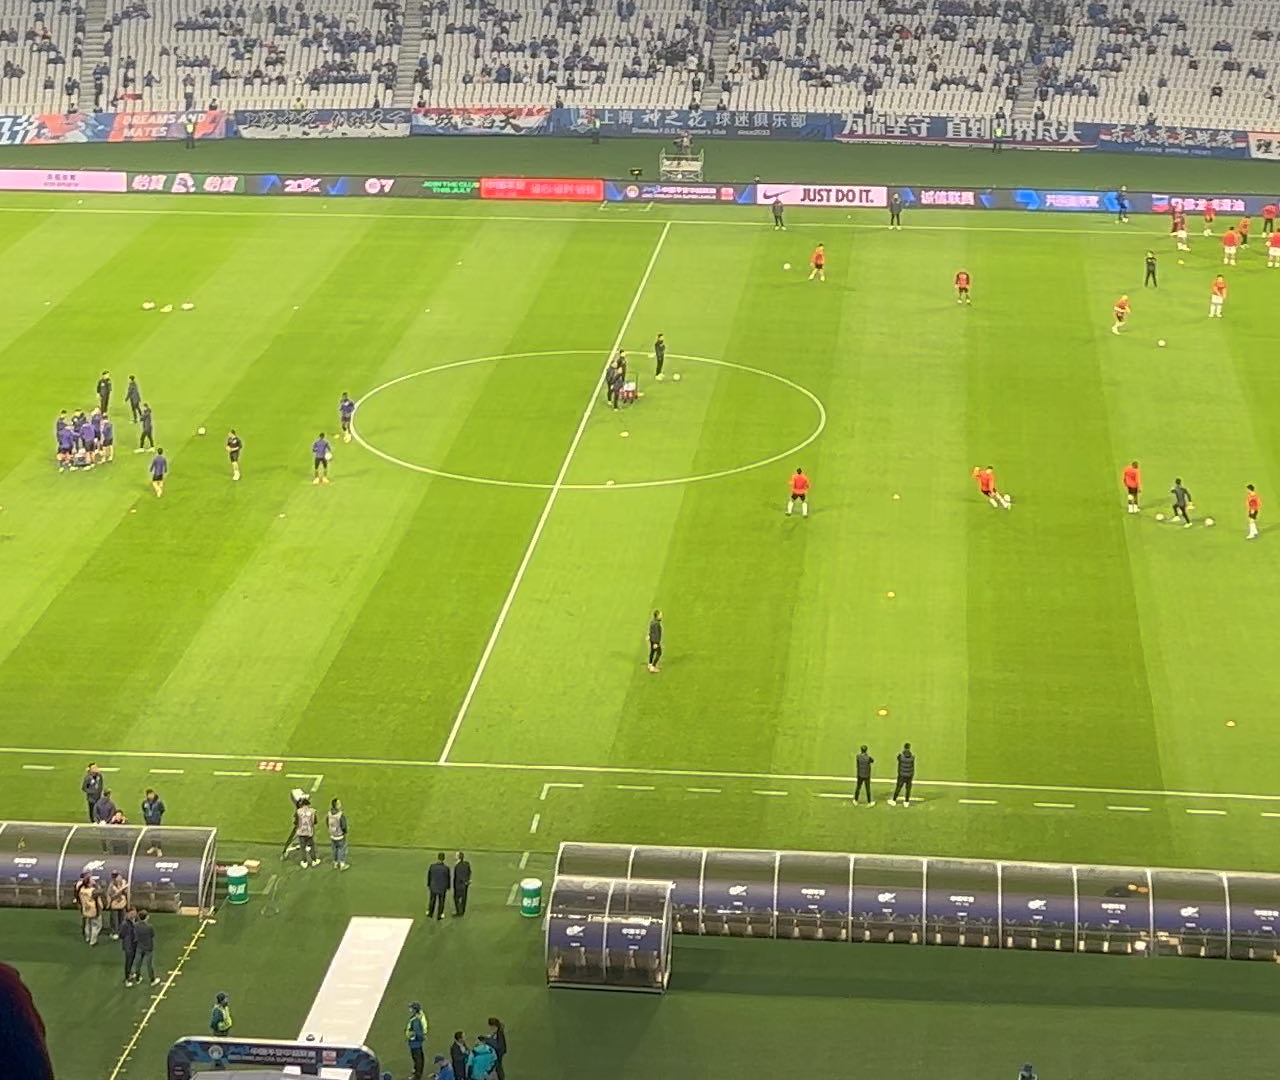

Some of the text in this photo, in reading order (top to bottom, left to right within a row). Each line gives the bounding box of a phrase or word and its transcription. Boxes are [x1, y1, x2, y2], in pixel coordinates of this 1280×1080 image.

[123, 113, 177, 125] DREAMS
[601, 110, 633, 125] 上海
[715, 112, 807, 128] 球迷俱乐部
[123, 126, 169, 138] MATES
[801, 188, 875, 204] JUST DO IT.
